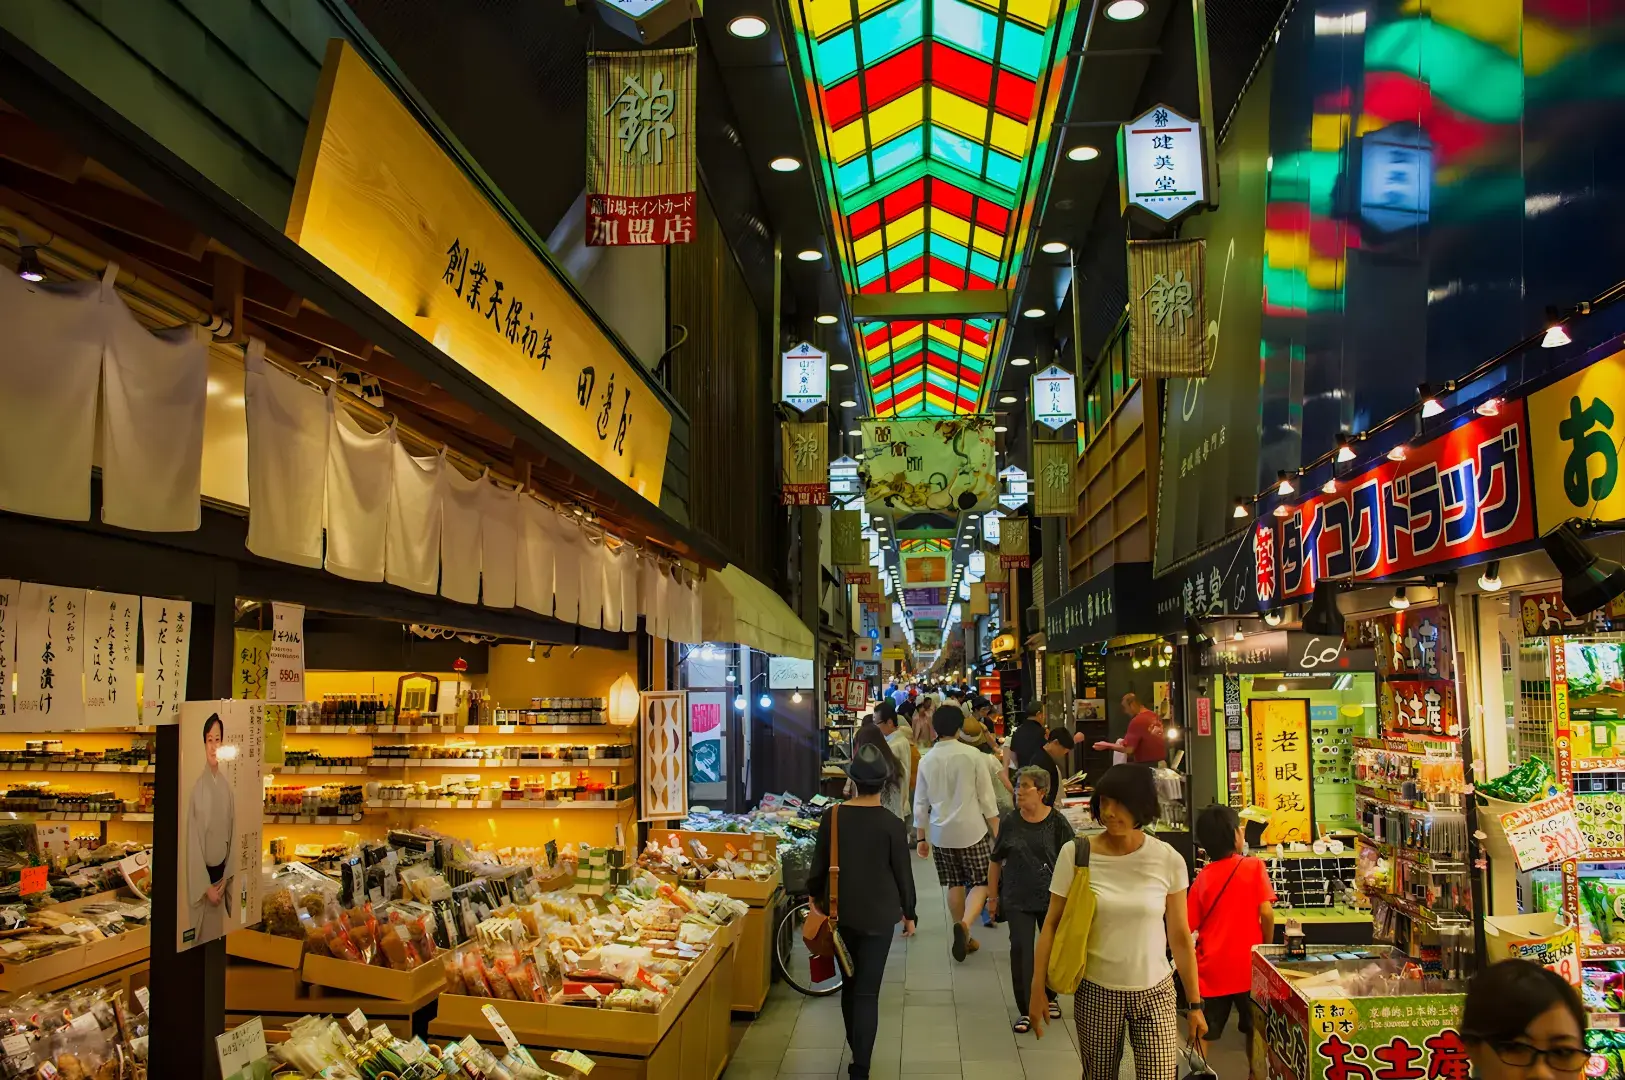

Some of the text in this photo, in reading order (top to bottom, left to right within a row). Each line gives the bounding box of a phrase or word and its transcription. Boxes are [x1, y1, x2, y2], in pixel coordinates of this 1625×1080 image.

[604, 70, 676, 165] 錦
[590, 214, 693, 245] 加盟店
[442, 237, 553, 371] 創業天保初年
[1140, 271, 1194, 337] 錦
[1041, 457, 1070, 494] 錦
[1559, 395, 1619, 508] お
[1253, 422, 1521, 602] 薬 ダイコクドラッグ
[1183, 566, 1224, 617] 健美堂
[40, 595, 57, 715] だし茶漬け
[156, 606, 168, 717] 上だしスープ
[1389, 618, 1438, 675] お土産
[1394, 687, 1444, 736] お土産
[1271, 730, 1305, 812] 老眼鏡
[1317, 1030, 1474, 1080] お土産
[1370, 1019, 1382, 1029] The
[1411, 1019, 1419, 1027] of
[1421, 1018, 1440, 1028] Kyoto
[1442, 1018, 1454, 1026] and
